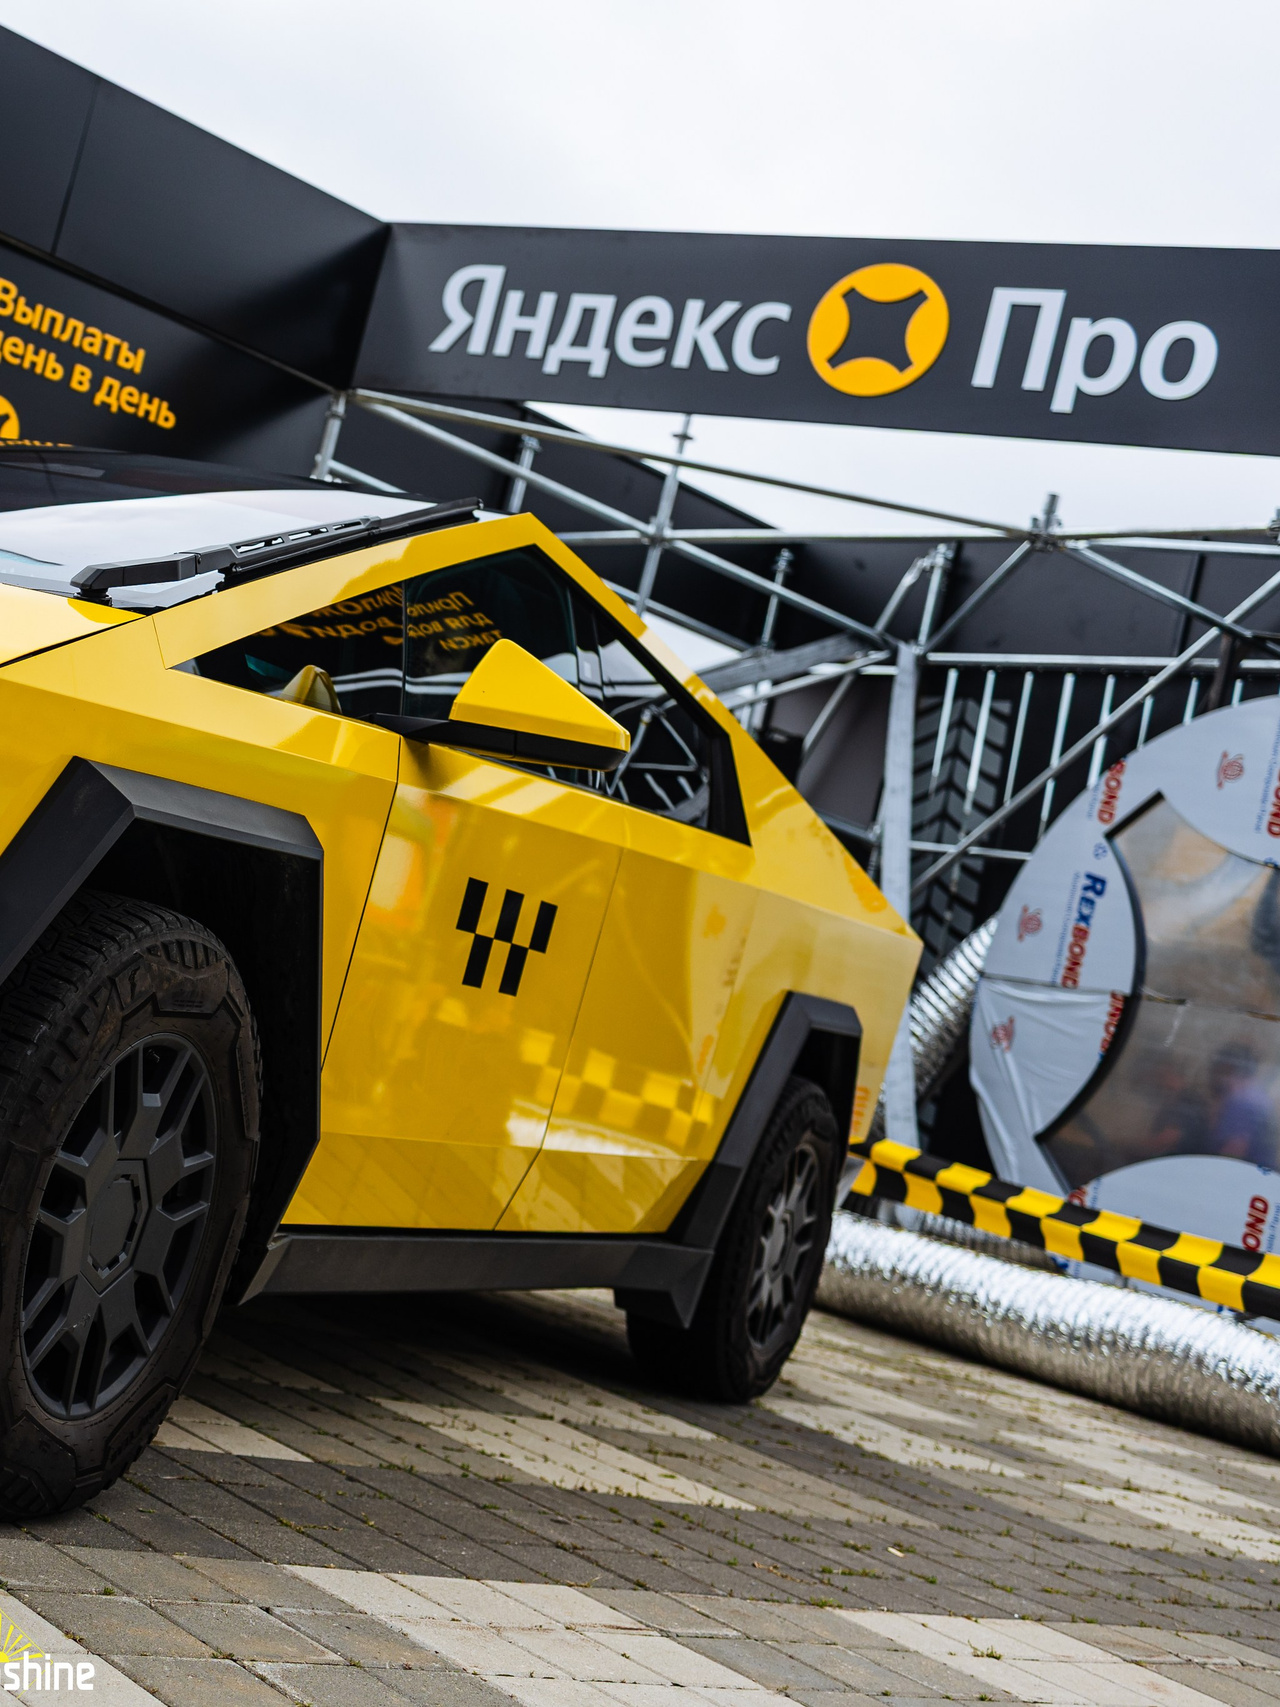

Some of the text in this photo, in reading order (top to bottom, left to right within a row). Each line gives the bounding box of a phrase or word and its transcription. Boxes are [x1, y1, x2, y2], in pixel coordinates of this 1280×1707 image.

[427, 263, 1218, 414] Яндекс Про
[69, 363, 93, 393] в
[93, 376, 177, 429] день
